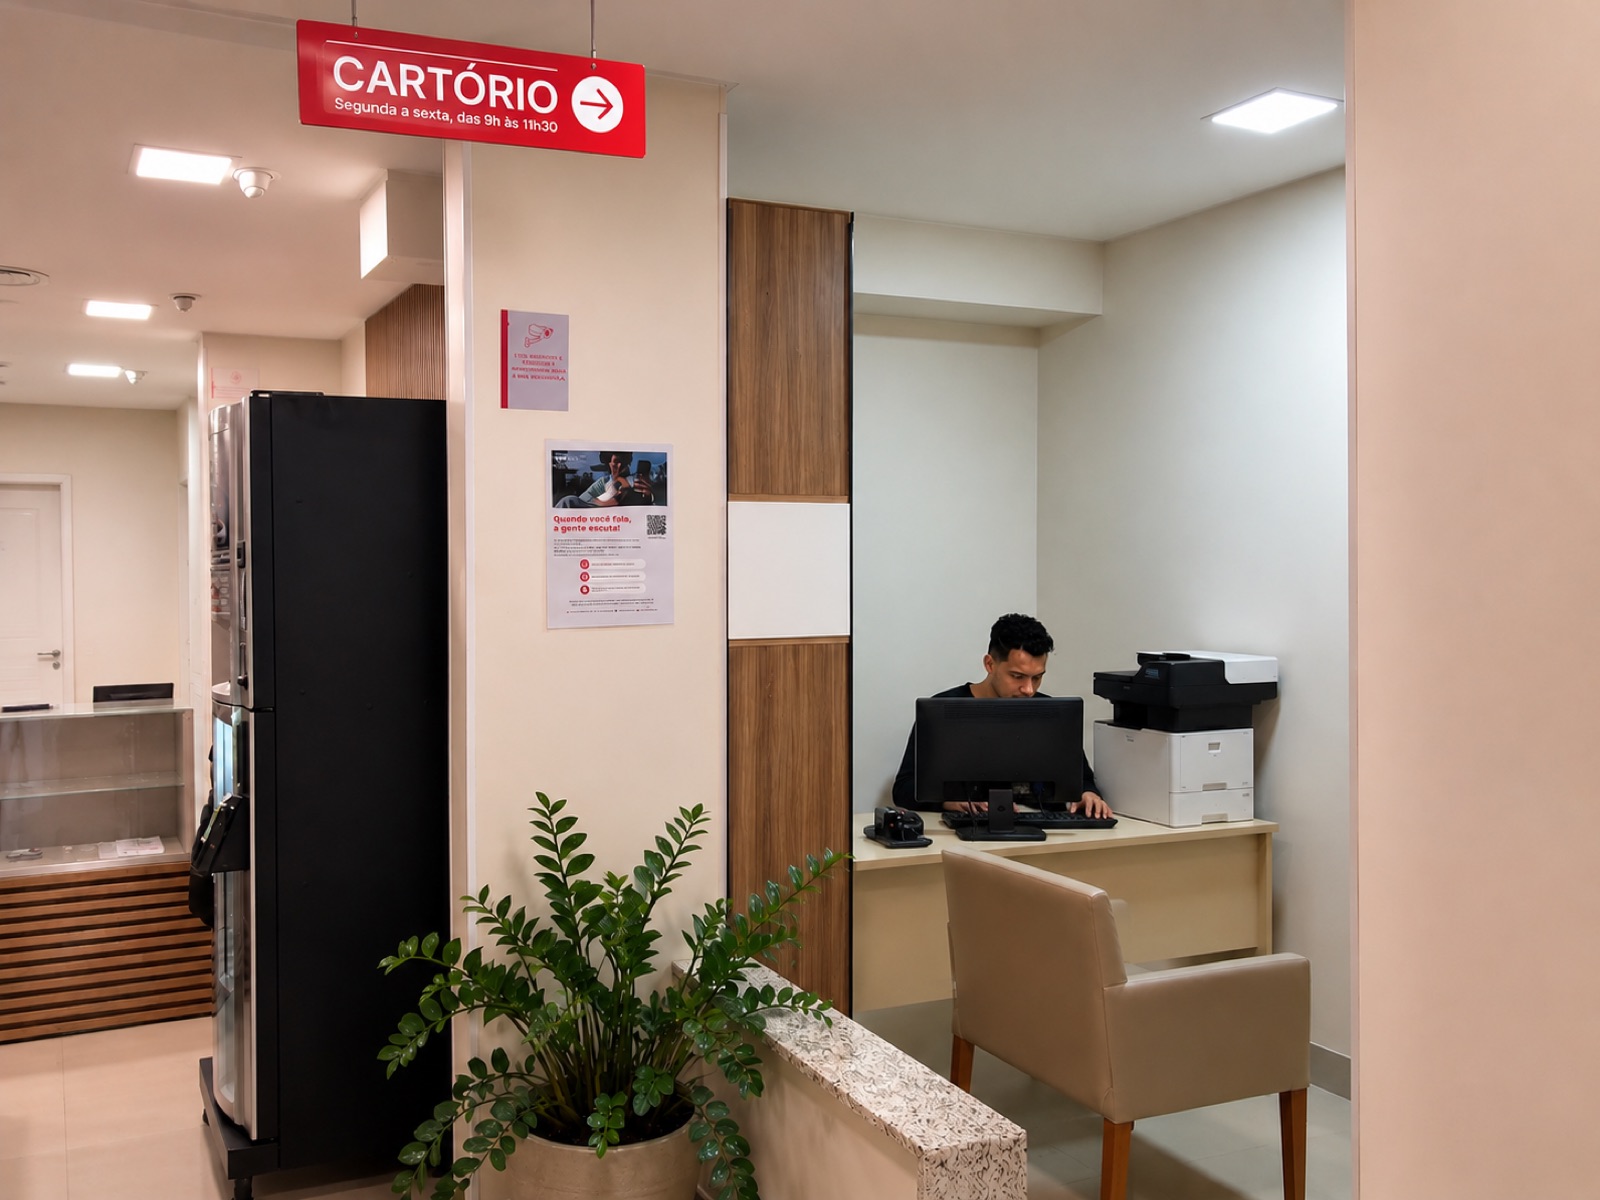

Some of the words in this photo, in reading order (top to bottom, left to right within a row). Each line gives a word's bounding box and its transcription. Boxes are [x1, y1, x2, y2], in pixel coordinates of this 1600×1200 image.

[333, 55, 558, 114] CARTÓRIO
[335, 97, 396, 115] Segunda
[401, 107, 410, 117] a
[413, 106, 454, 123] sexta,
[457, 111, 481, 125] das
[484, 113, 500, 127] 9h
[504, 115, 519, 129] às
[523, 118, 558, 133] 11h30
